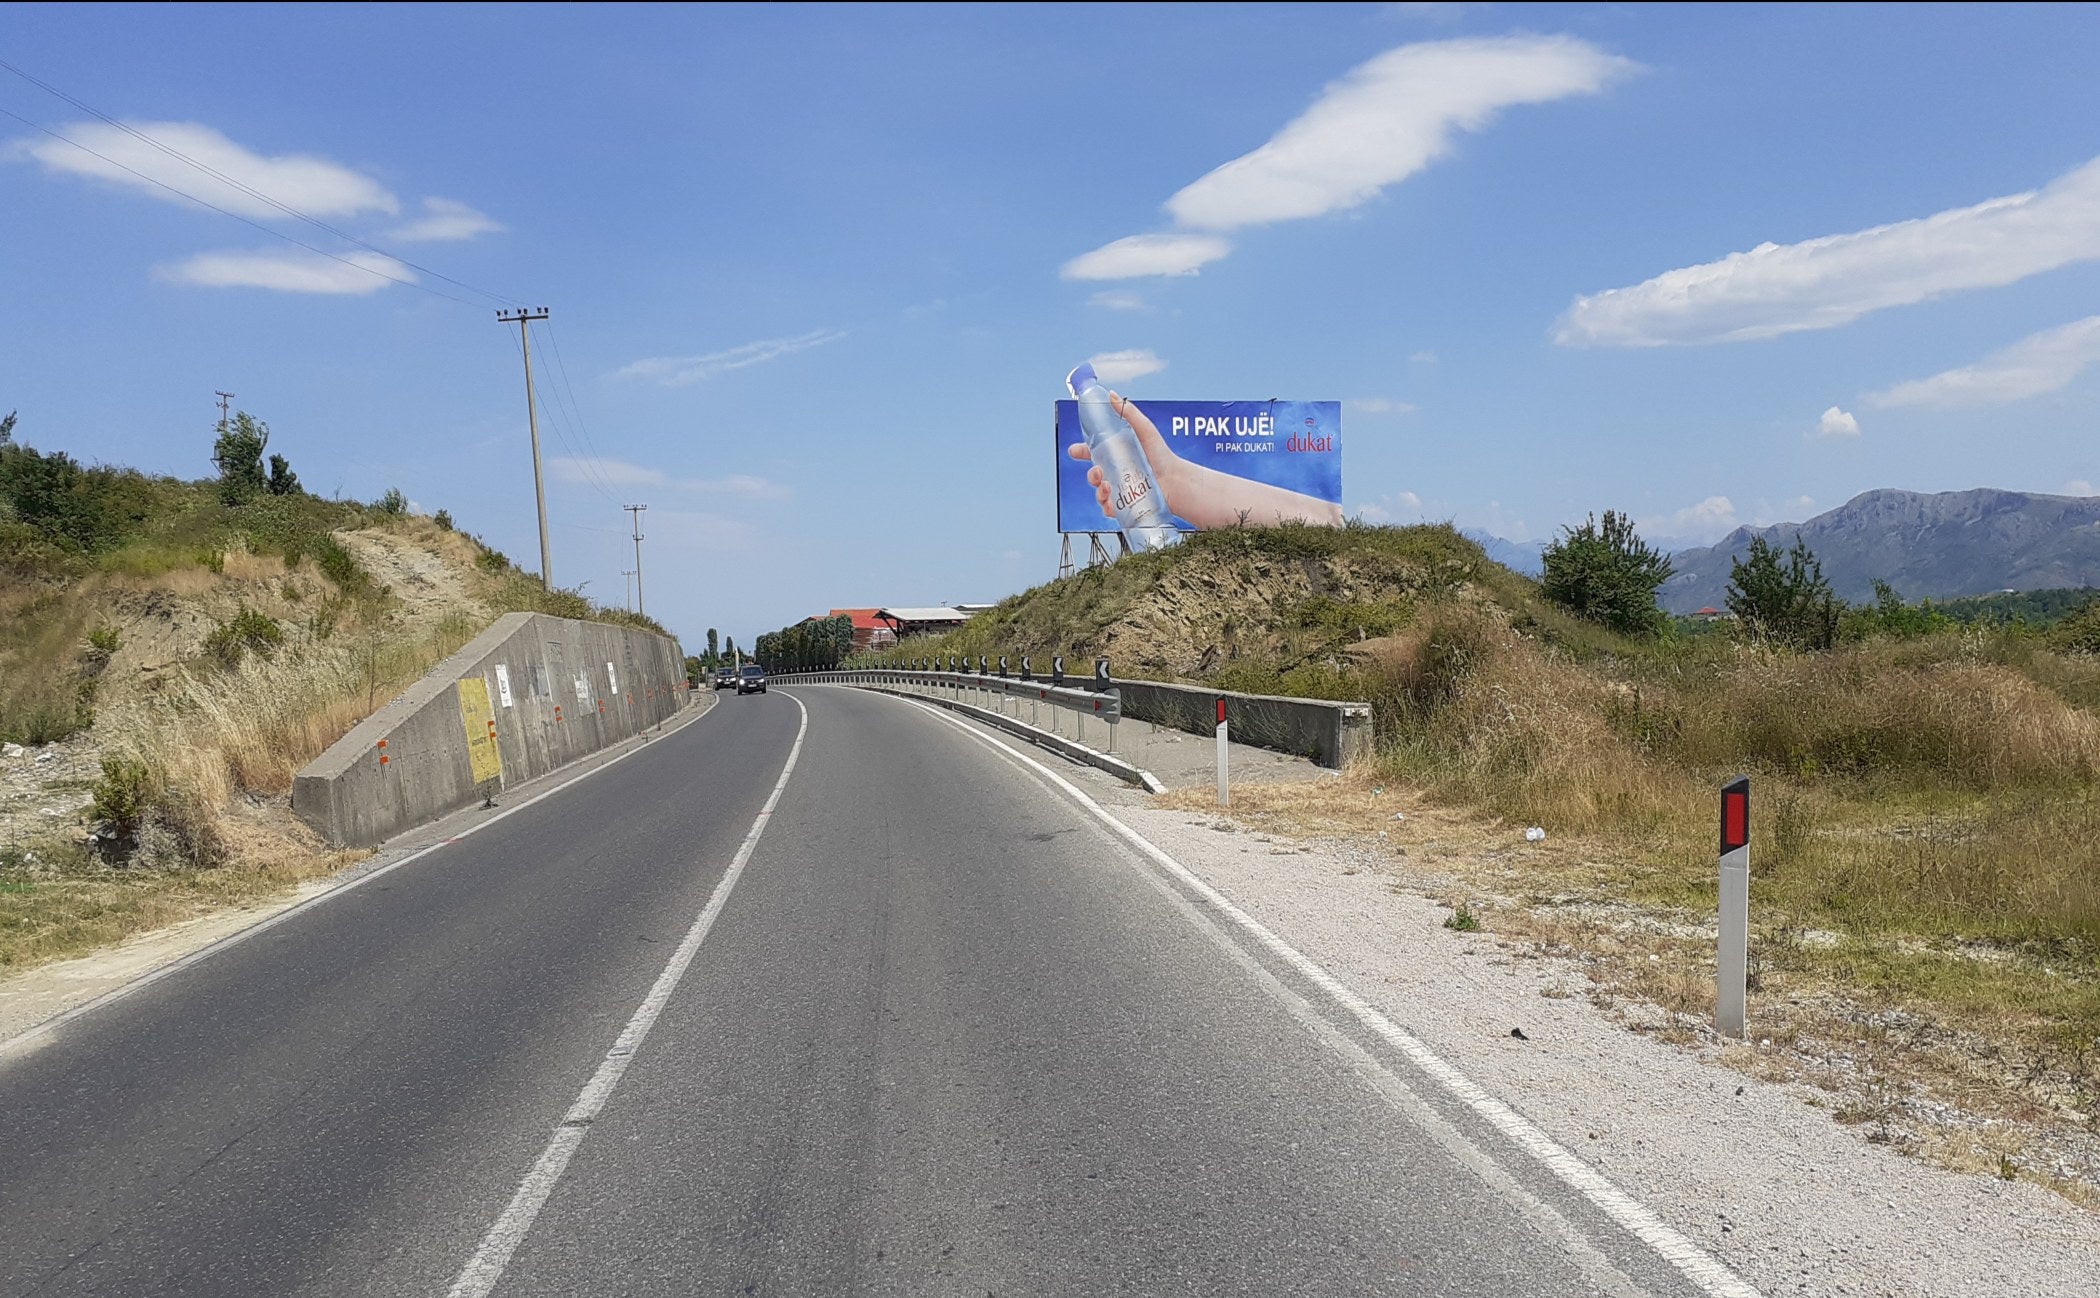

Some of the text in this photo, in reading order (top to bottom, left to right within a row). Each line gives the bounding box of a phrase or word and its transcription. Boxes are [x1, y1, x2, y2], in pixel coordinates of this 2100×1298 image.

[1172, 412, 1274, 436] PI PAK UJË!
[1215, 442, 1275, 453] PI PAK DUKAT!
[1286, 432, 1333, 453] dukat
[1116, 475, 1152, 511] dukat
